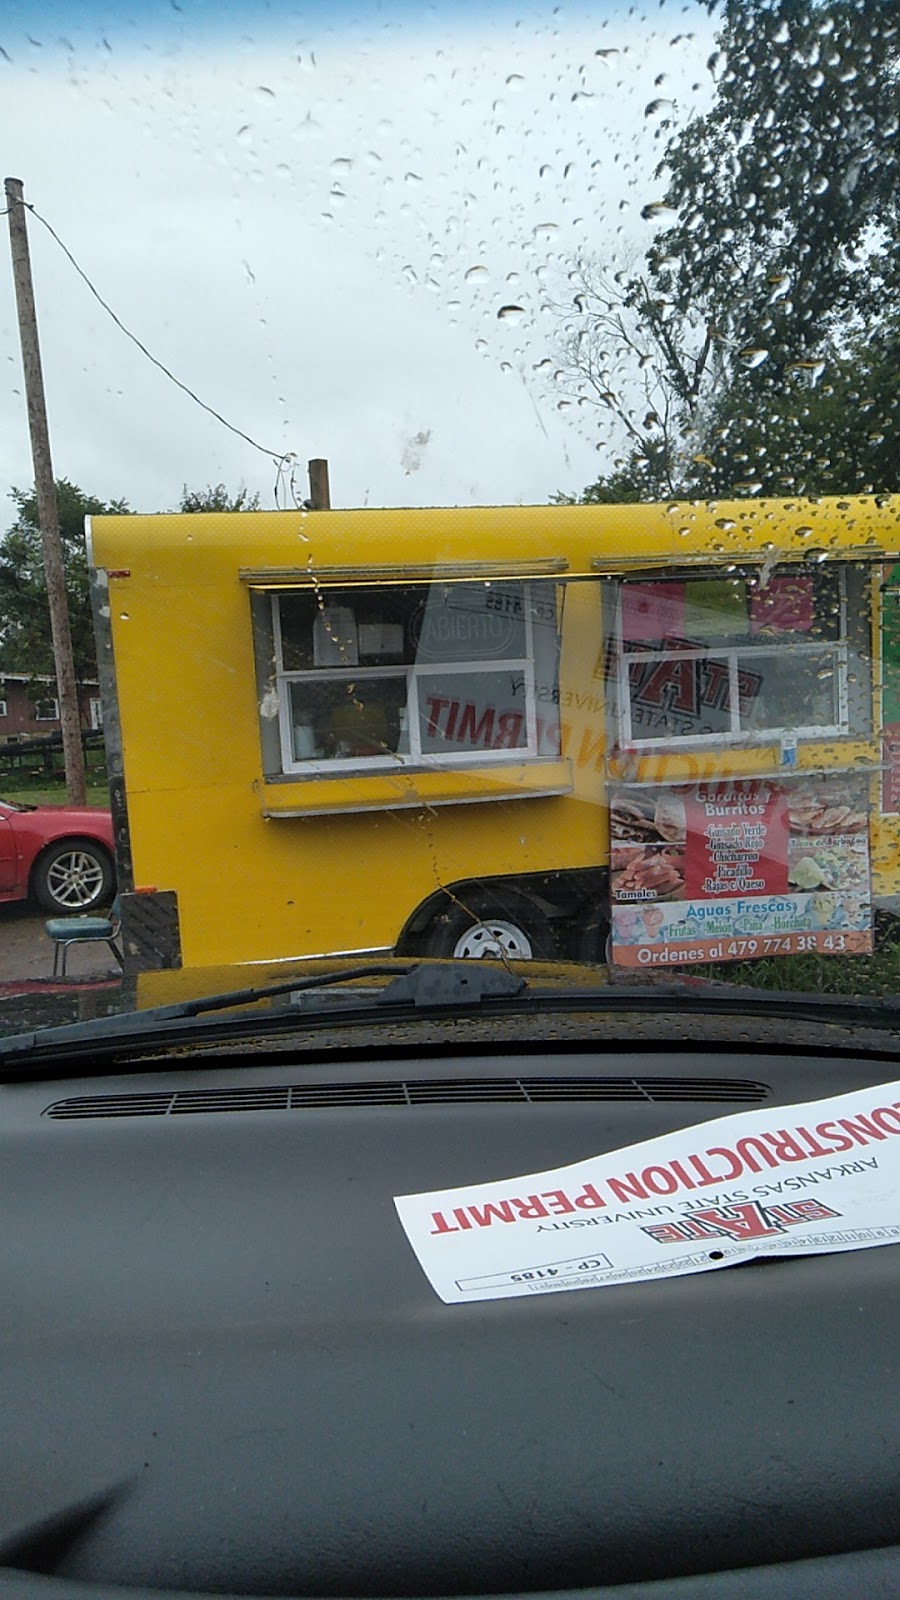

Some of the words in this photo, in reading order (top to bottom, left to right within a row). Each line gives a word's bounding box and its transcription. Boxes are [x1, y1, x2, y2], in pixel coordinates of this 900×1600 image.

[704, 803, 766, 817] Burritos
[741, 821, 767, 836] Verde
[743, 836, 765, 851] Rojo
[790, 839, 813, 847] Tcos
[739, 877, 766, 893] Queso
[614, 889, 657, 900] Tamales
[686, 904, 731, 920] Aguas
[736, 901, 792, 914] Frescas
[637, 947, 704, 964] Ordenes
[709, 942, 722, 958] al
[728, 939, 758, 956] 479
[763, 937, 791, 953] 774
[796, 935, 817, 951] 38
[823, 935, 845, 950] 43
[605, 1101, 900, 1204] ONSTRUCTION
[752, 1157, 879, 1198] ARKANSAS
[430, 1183, 607, 1235] PERMIT
[677, 1190, 750, 1211] STATE
[536, 1205, 675, 1233] UNIVERSITY
[641, 1199, 843, 1243] STATE
[578, 1260, 601, 1270] CP
[510, 1268, 558, 1281] 4185
